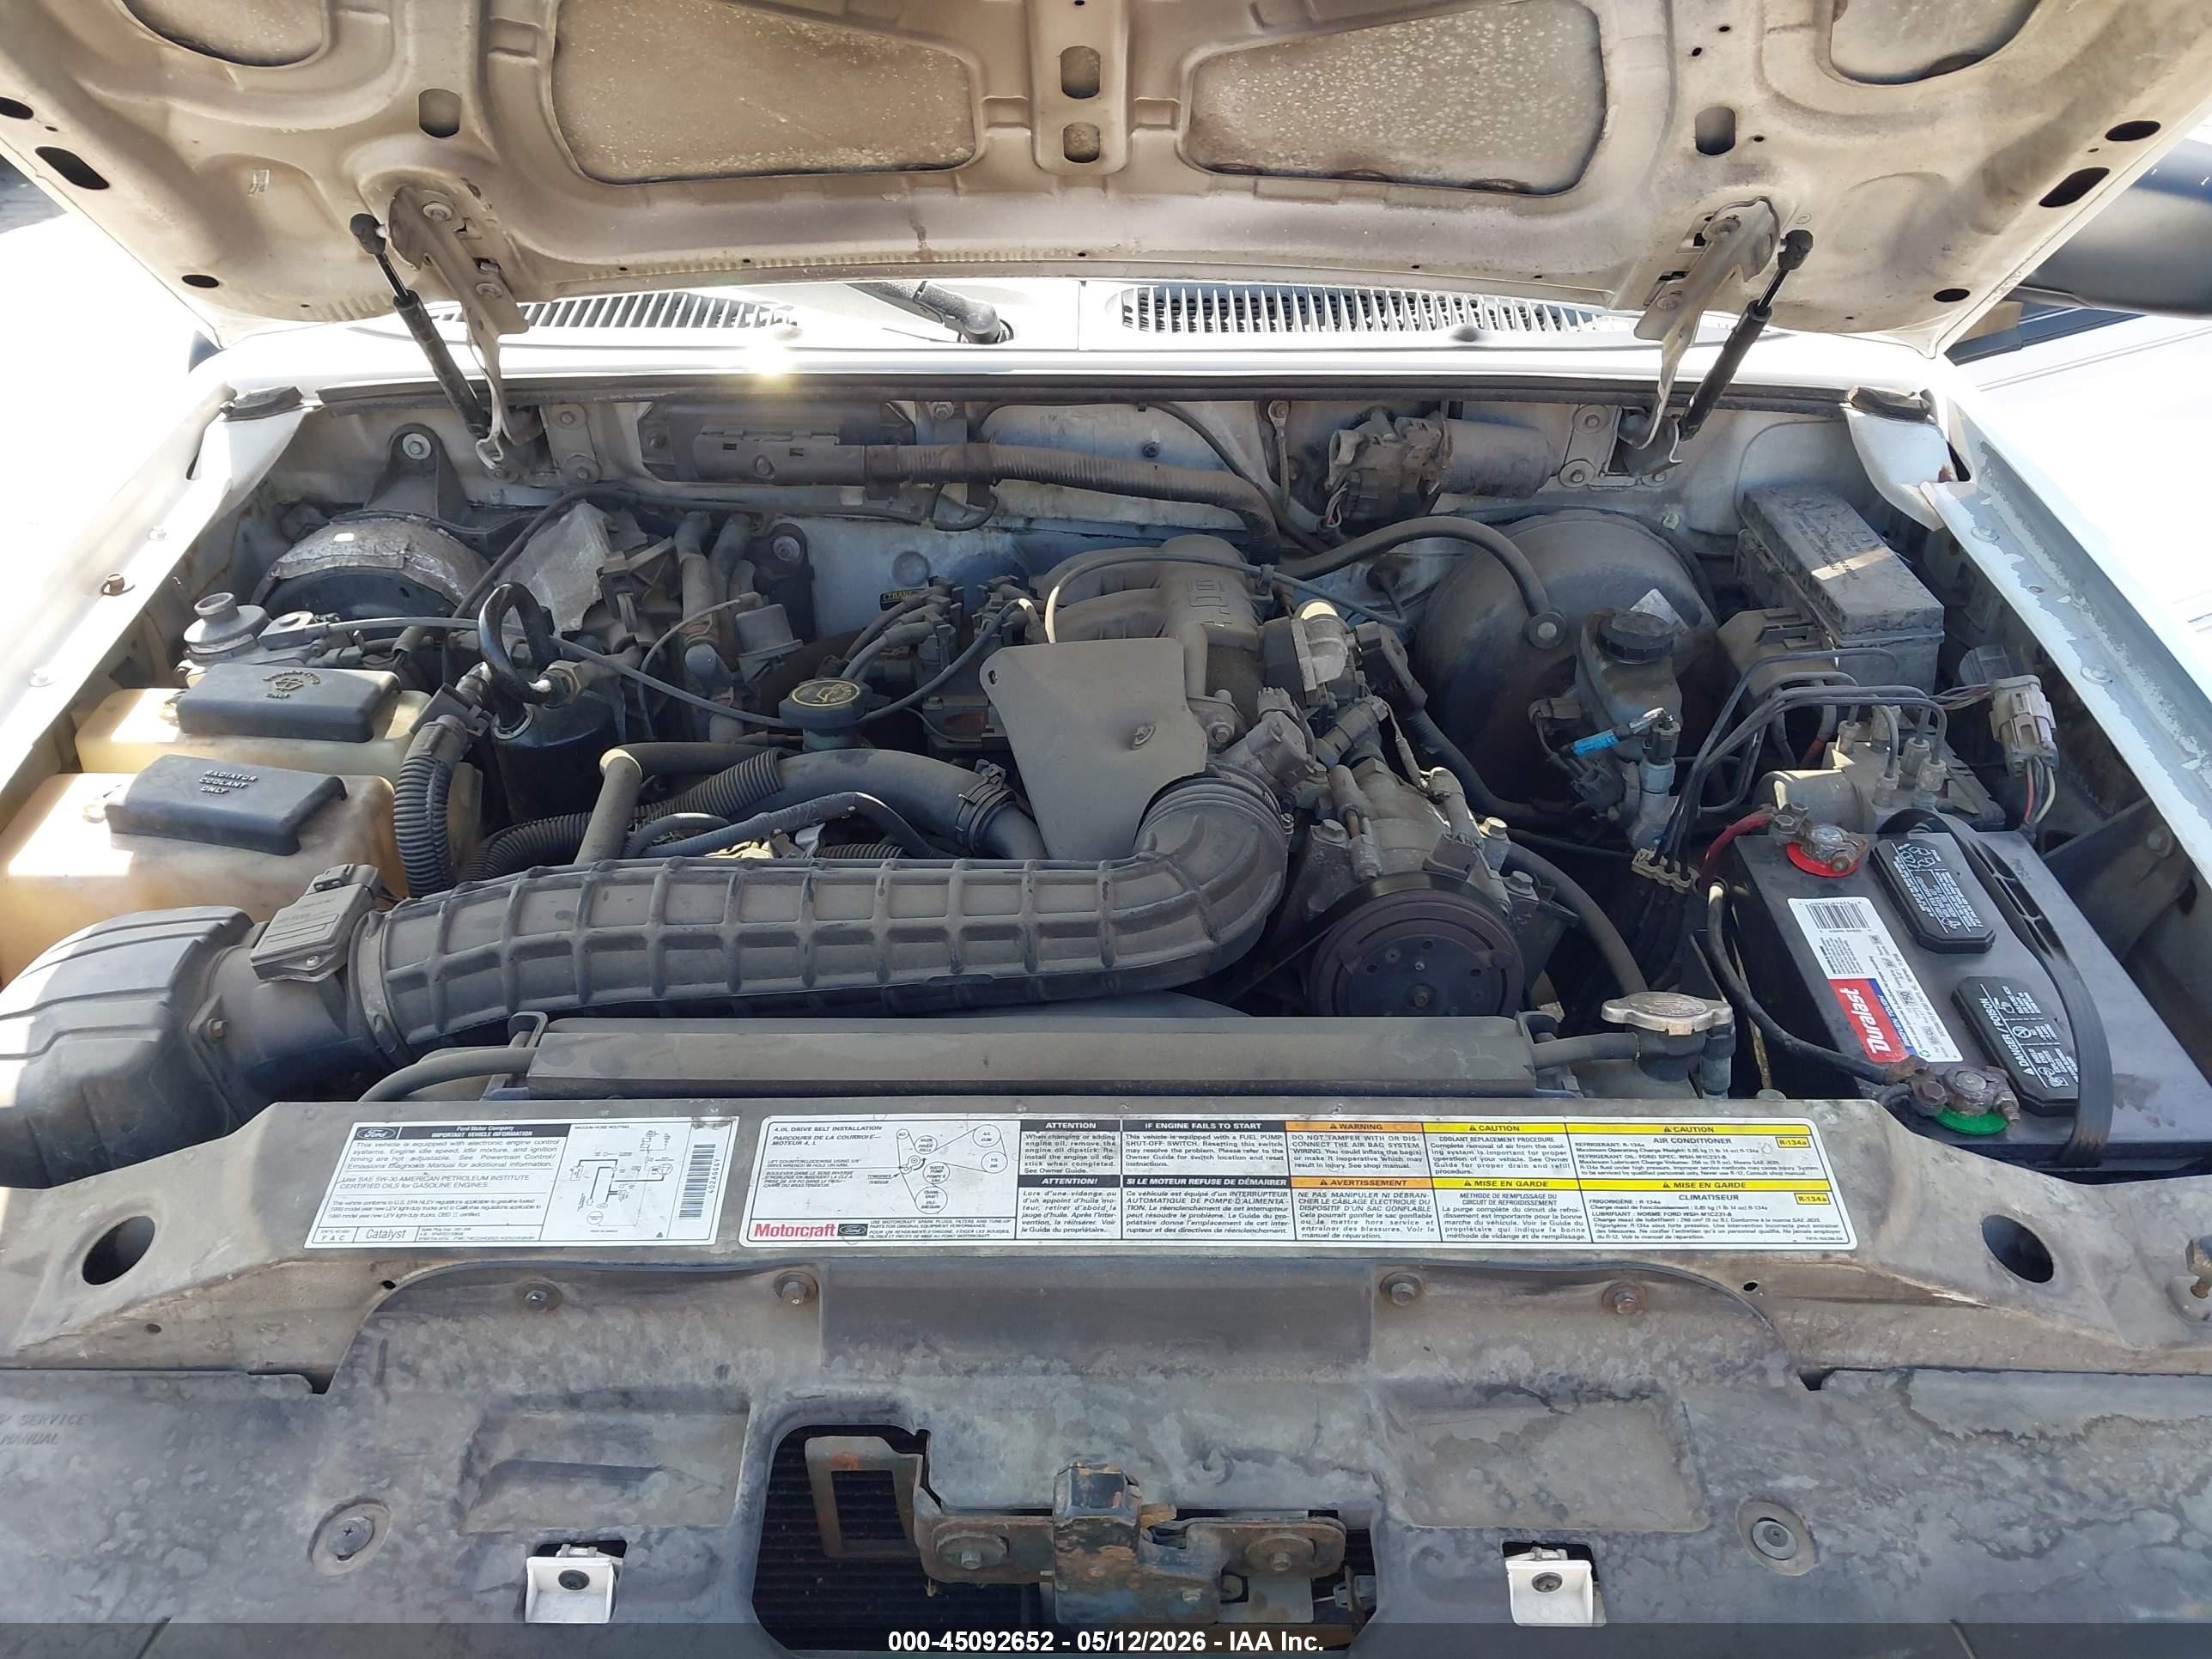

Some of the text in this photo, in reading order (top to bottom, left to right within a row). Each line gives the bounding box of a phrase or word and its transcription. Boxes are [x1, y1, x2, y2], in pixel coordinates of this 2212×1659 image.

[199, 777, 249, 788] COOLANT
[205, 770, 258, 782] RADIATOR
[200, 786, 229, 794] ONLY
[1978, 999, 2004, 1026] POISON
[1839, 988, 1891, 1054] Duralast
[1892, 1017, 1912, 1048] PROVEN
[2002, 1034, 2030, 1066] DANGER
[366, 1229, 406, 1241] Catalyst
[754, 1224, 836, 1237] Motorcraft
